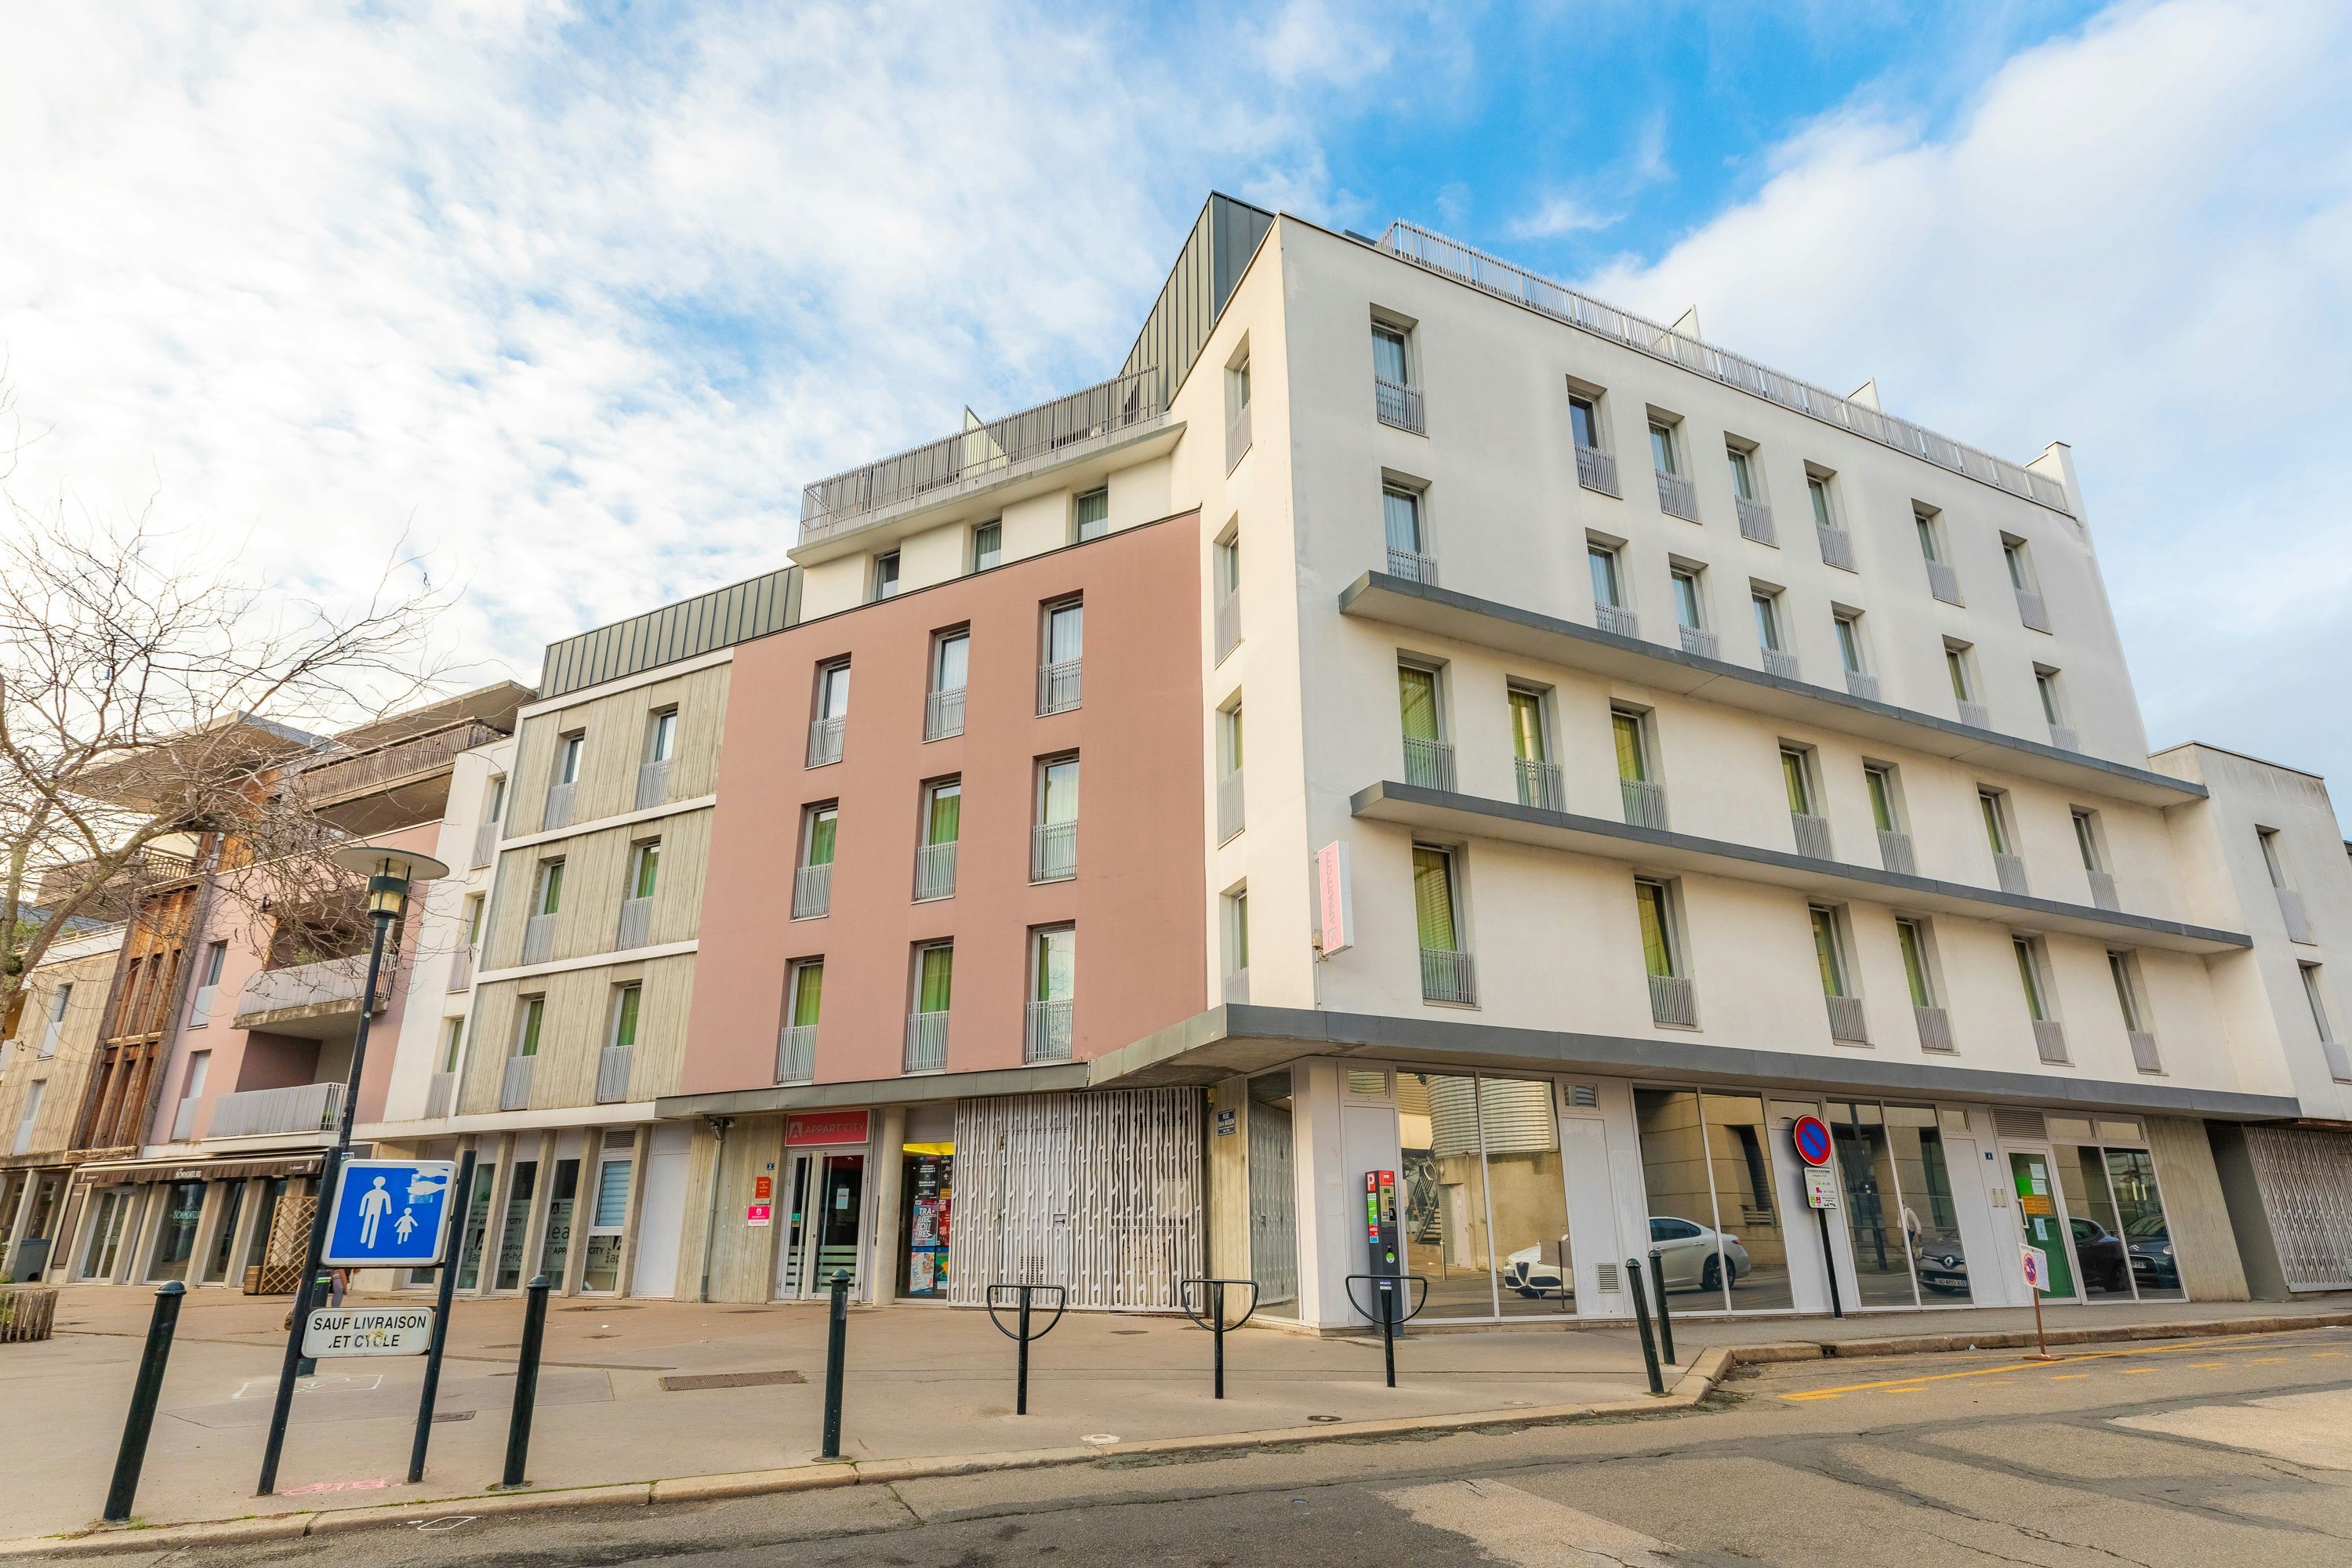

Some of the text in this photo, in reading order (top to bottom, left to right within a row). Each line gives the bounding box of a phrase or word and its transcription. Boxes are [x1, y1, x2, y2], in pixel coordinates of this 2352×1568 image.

[805, 1123, 865, 1135] APPART'CITY
[1367, 1174, 1375, 1191] P
[314, 1316, 426, 1330] SAUF LIVRAISON
[332, 1335, 351, 1348] ET
